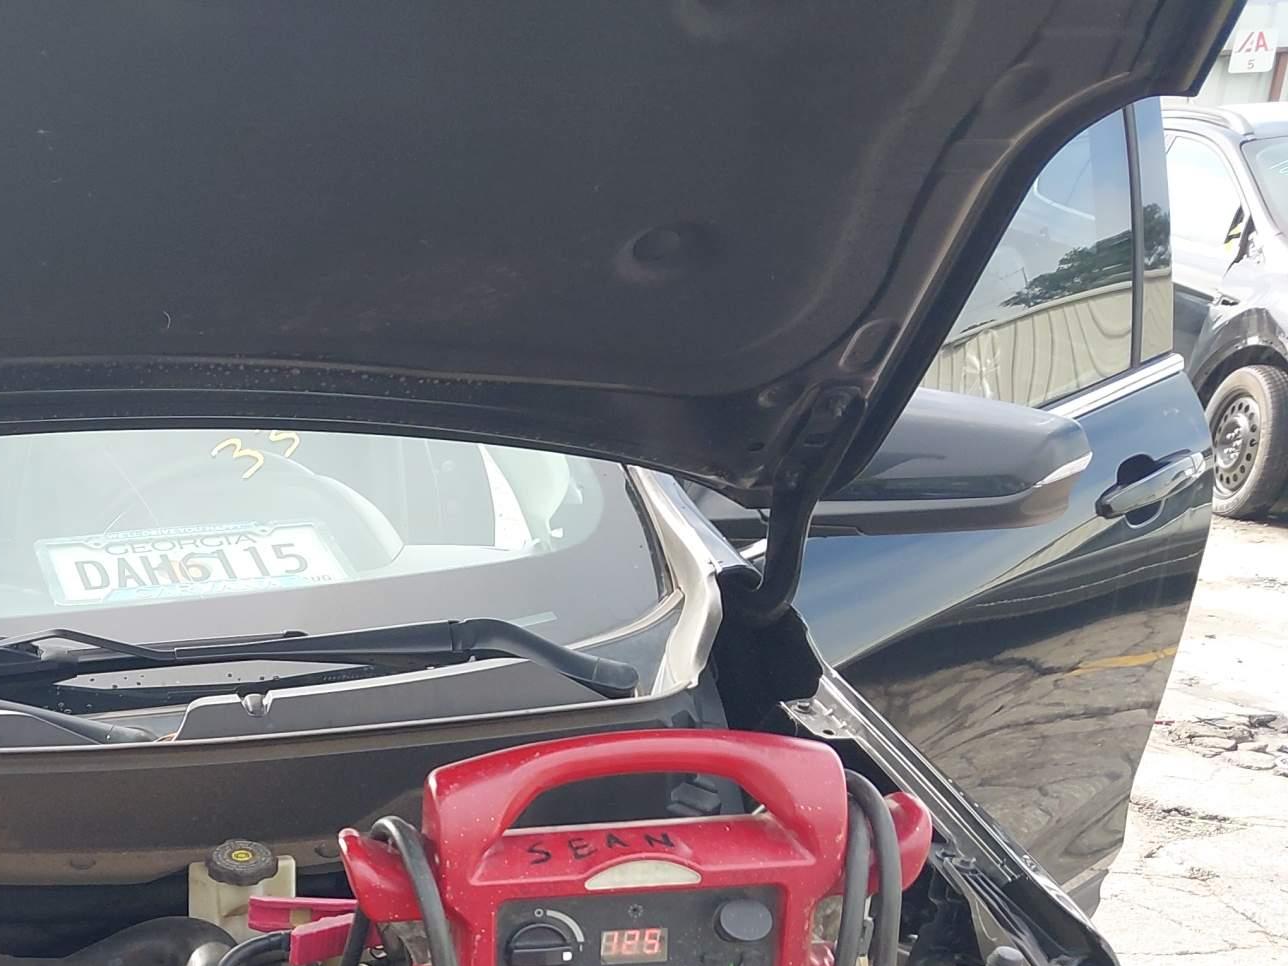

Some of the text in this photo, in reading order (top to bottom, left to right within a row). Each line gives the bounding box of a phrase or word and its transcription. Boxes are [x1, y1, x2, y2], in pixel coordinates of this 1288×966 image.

[1247, 59, 1255, 70] 5
[103, 532, 257, 555] GEORGIA
[74, 542, 309, 591] DAH6115
[526, 832, 675, 865] SEAN
